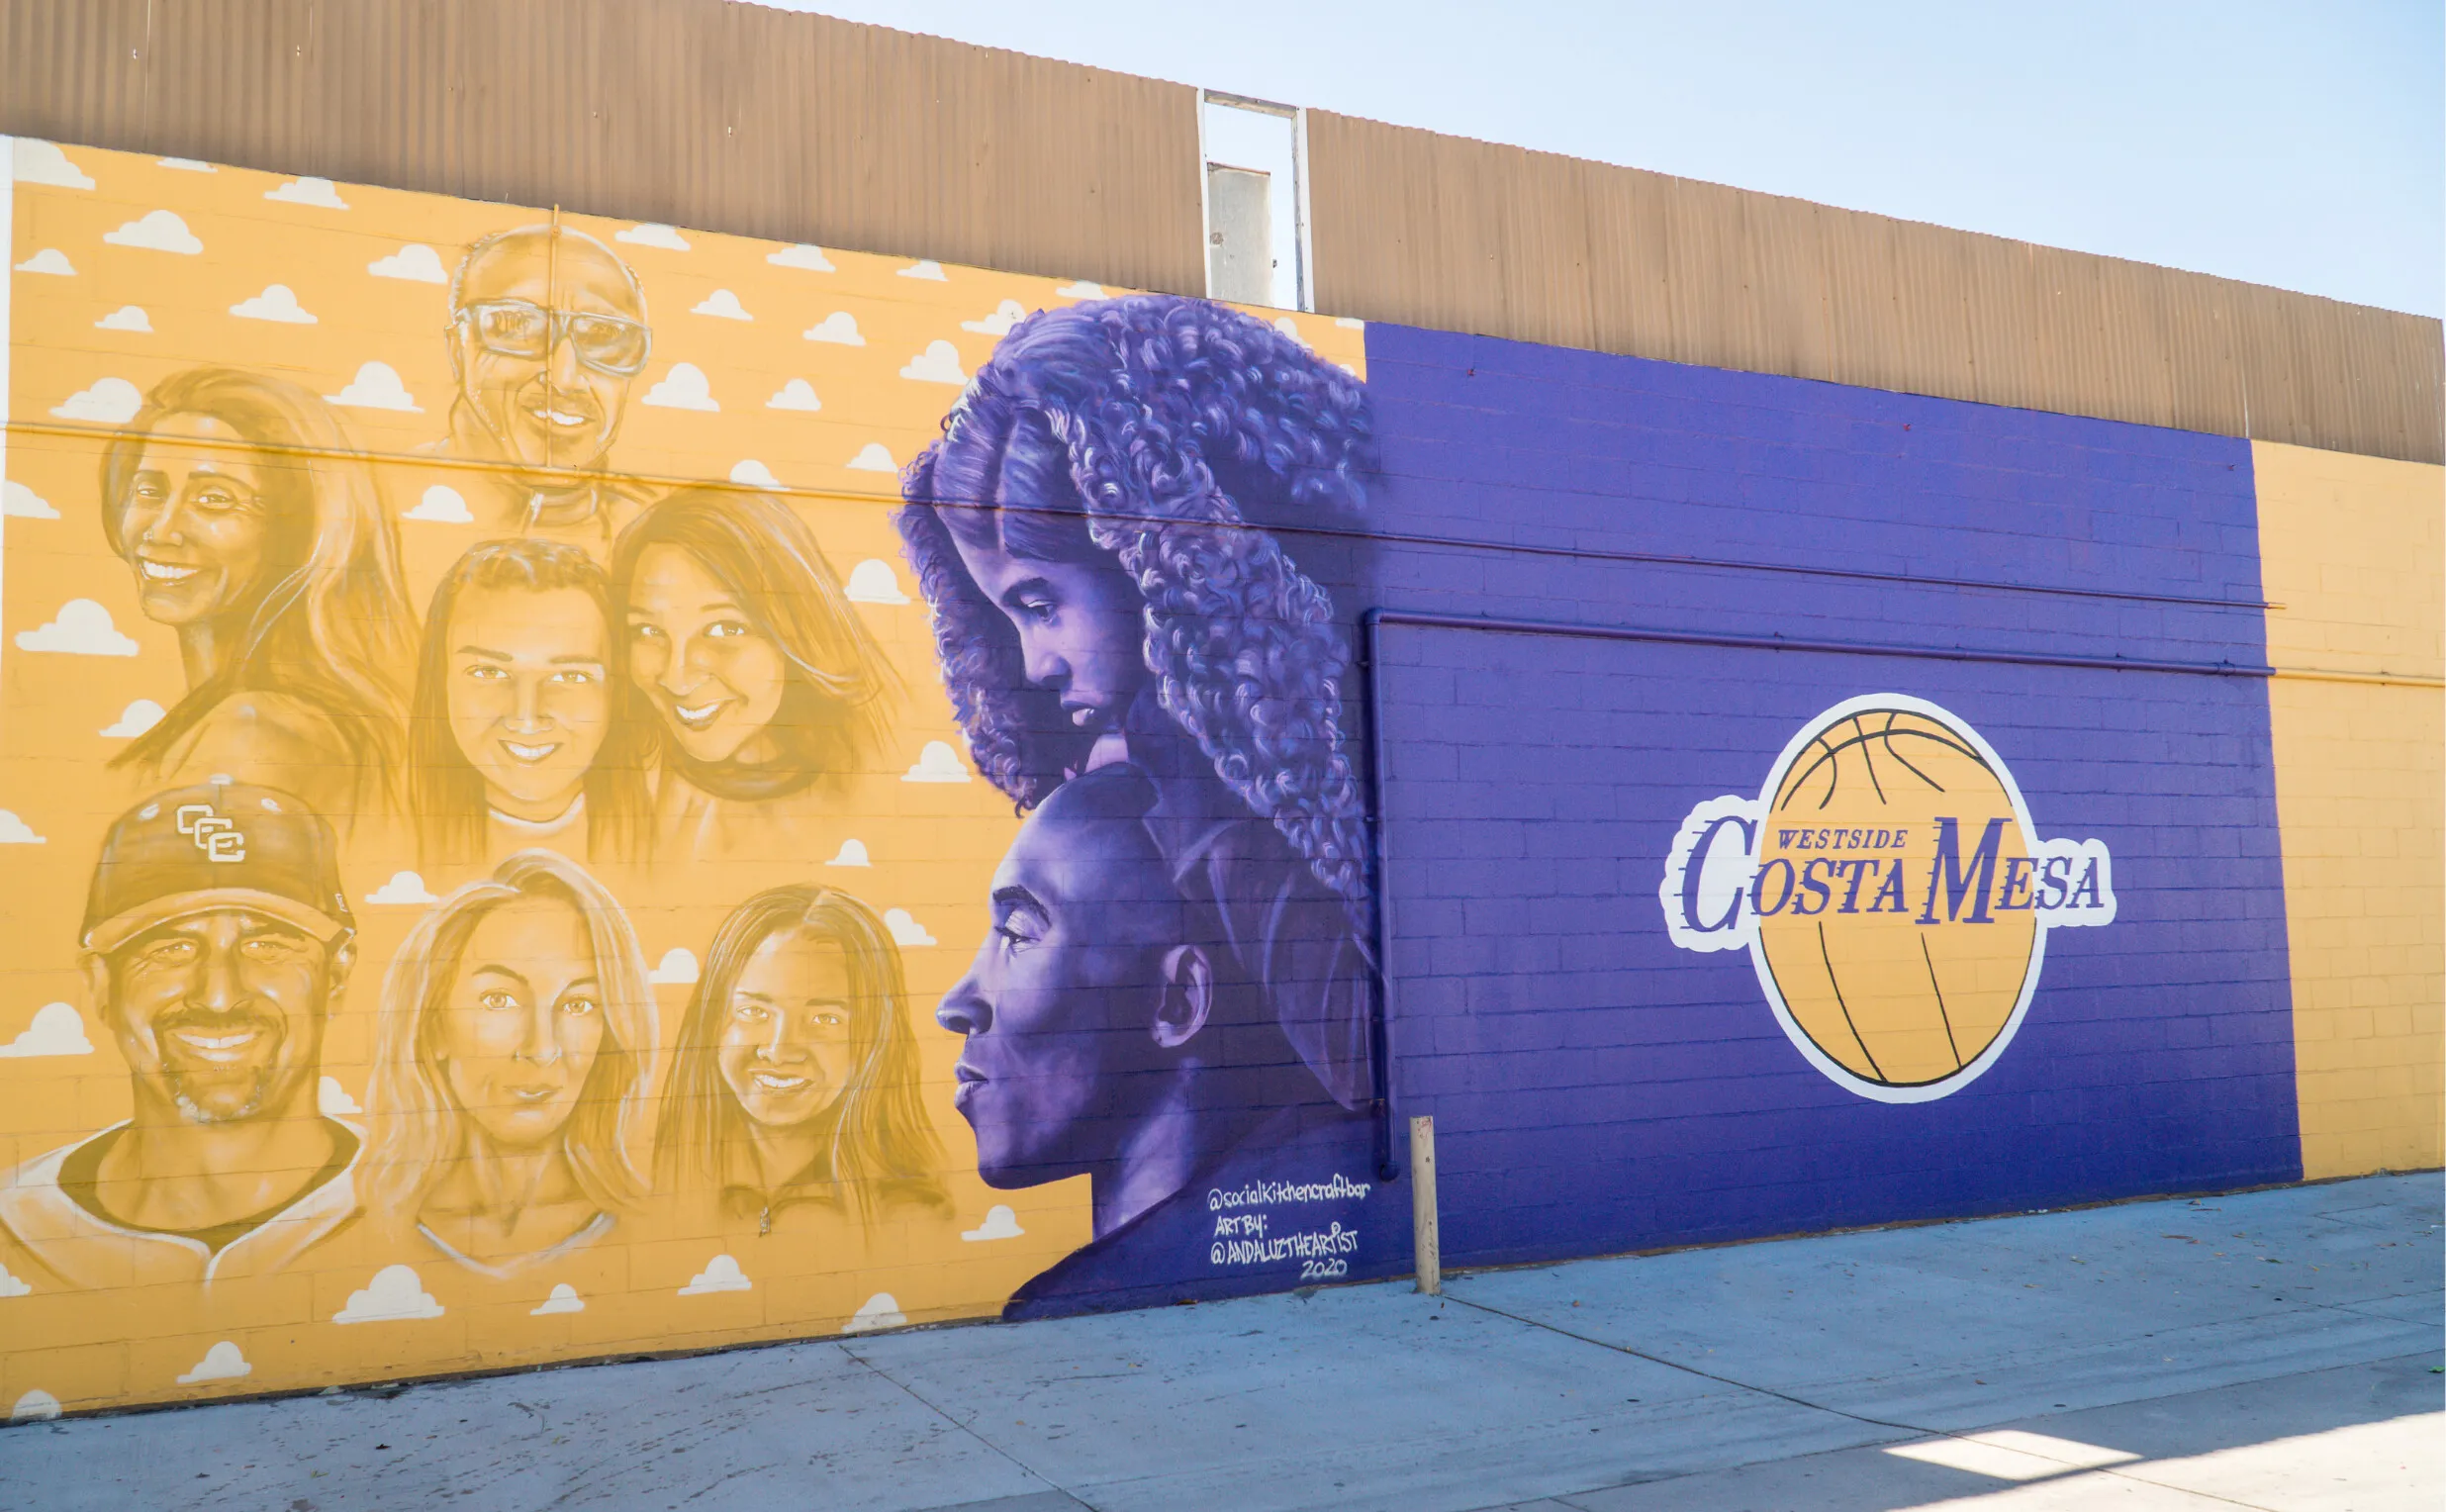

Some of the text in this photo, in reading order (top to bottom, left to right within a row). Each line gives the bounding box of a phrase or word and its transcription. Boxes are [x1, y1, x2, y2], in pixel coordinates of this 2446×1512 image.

[1778, 828, 1909, 850] WESTSIDE
[1673, 814, 2105, 933] COSTA MESA
[1214, 1214, 1269, 1238] ART BY:
[1300, 1258, 1348, 1281] 2020
